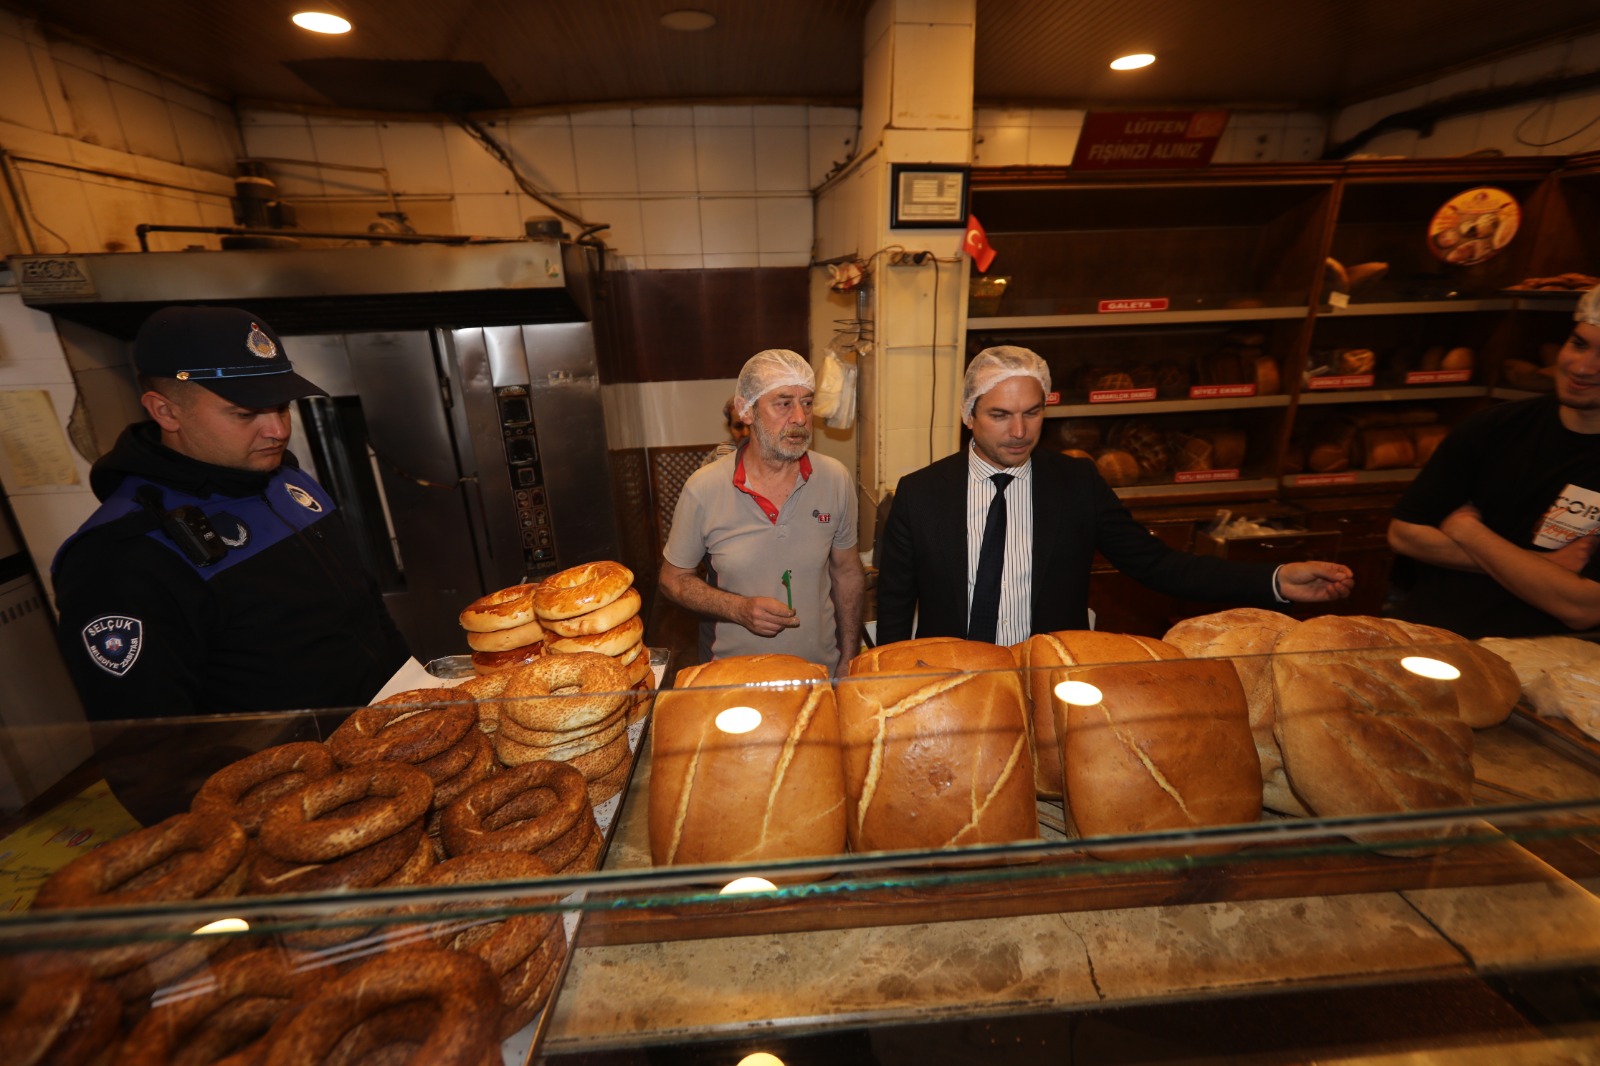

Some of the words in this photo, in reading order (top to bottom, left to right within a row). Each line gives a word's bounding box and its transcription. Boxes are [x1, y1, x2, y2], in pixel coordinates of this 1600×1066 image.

[1124, 118, 1187, 134] LÜTFEN
[1088, 139, 1152, 163] FİŞİNİZİ
[1151, 142, 1204, 159] ALINIZ
[1108, 302, 1151, 310] GALETA
[88, 619, 133, 637] SELÇUK
[90, 644, 120, 669] BELEDİYE
